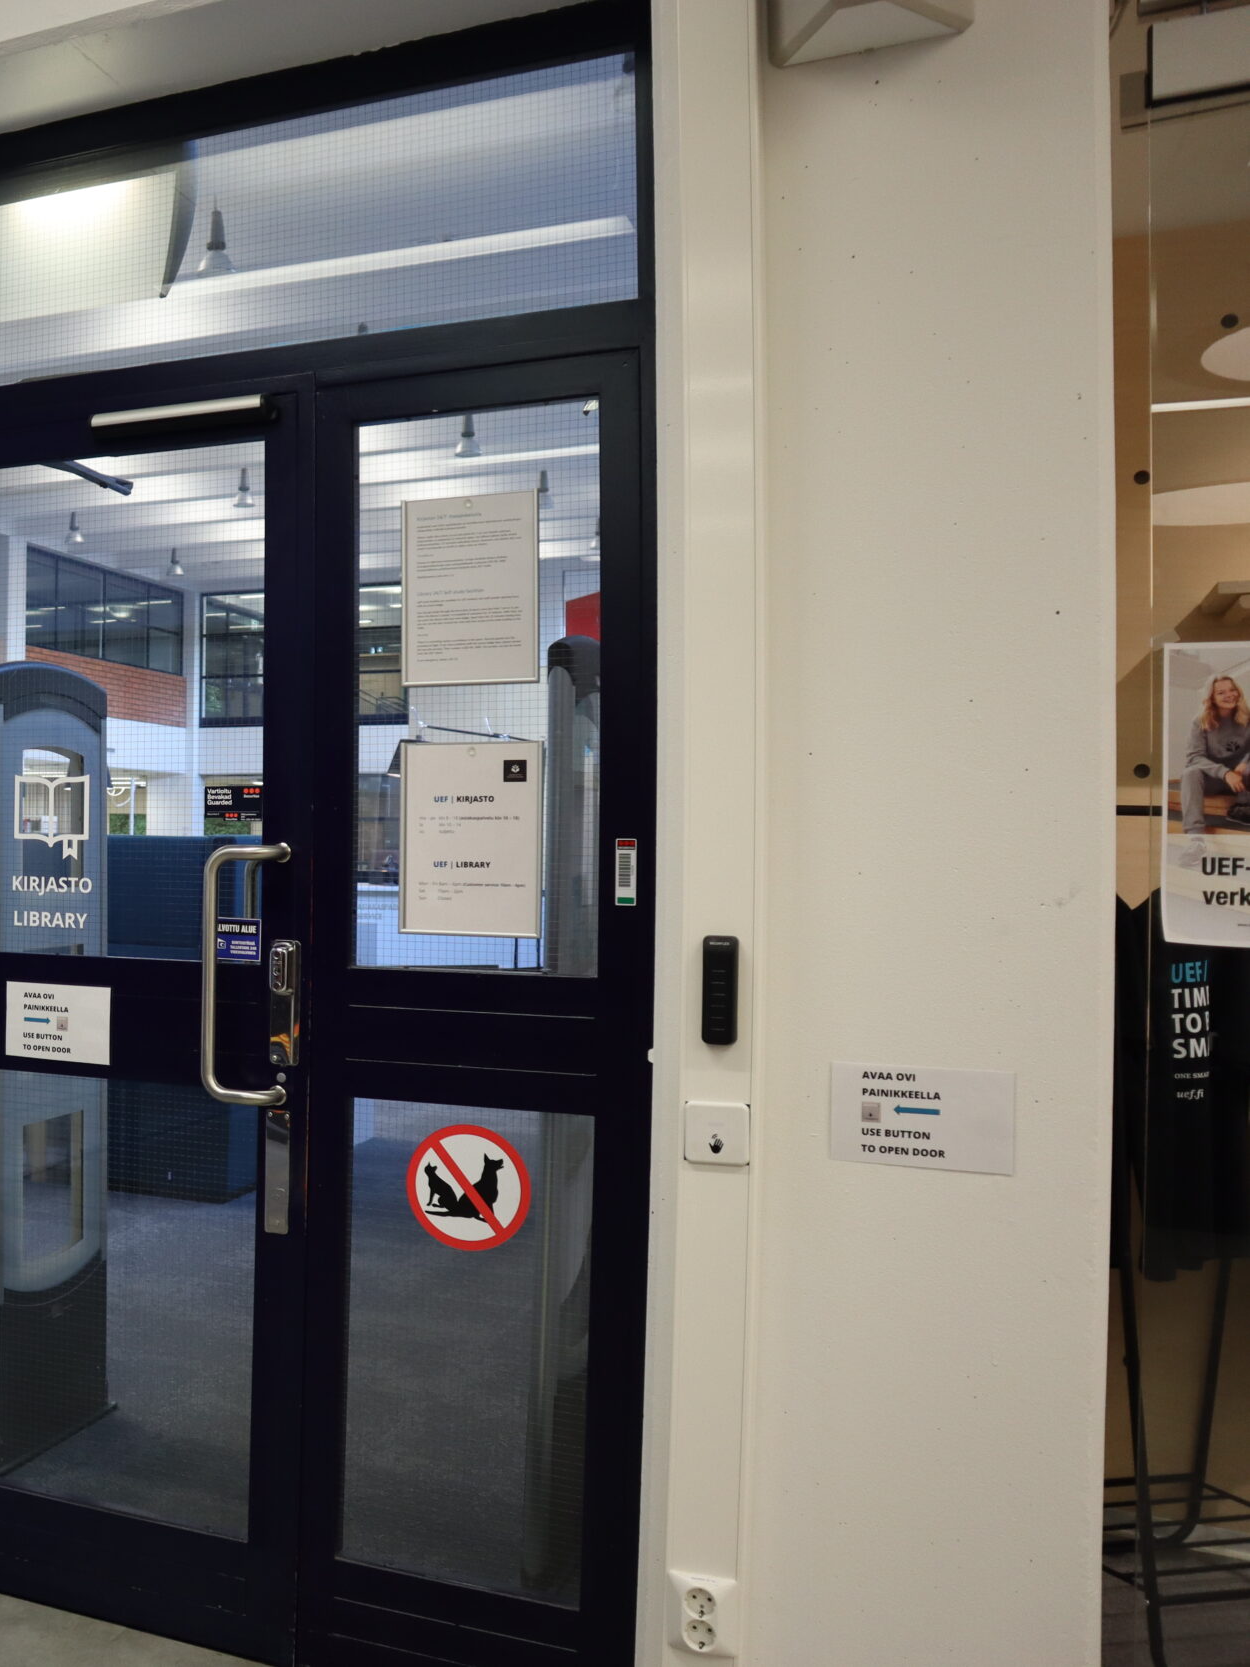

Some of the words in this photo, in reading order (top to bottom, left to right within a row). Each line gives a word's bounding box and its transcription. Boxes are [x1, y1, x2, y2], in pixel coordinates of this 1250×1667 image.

[433, 795, 449, 803] UEF
[456, 795, 495, 805] KIRJASTO
[455, 861, 491, 869] LIBRARY
[11, 875, 93, 896] KIRJASTO
[13, 910, 88, 930] LIBRARY
[241, 925, 257, 934] ALUE
[23, 991, 41, 999] AVAA
[23, 1004, 69, 1013] PAINIKKEELLA
[36, 1033, 63, 1041] BUTTON
[51, 1046, 71, 1054] DOOR
[862, 1071, 893, 1081] AVAA
[896, 1073, 916, 1082] OVI
[862, 1088, 941, 1100] PAINIKKEELLA
[861, 1128, 882, 1137] USE
[884, 1129, 931, 1140] BUTTON
[861, 1144, 876, 1153] TO
[879, 1145, 909, 1156] OPEN
[912, 1148, 946, 1159] DOOR
